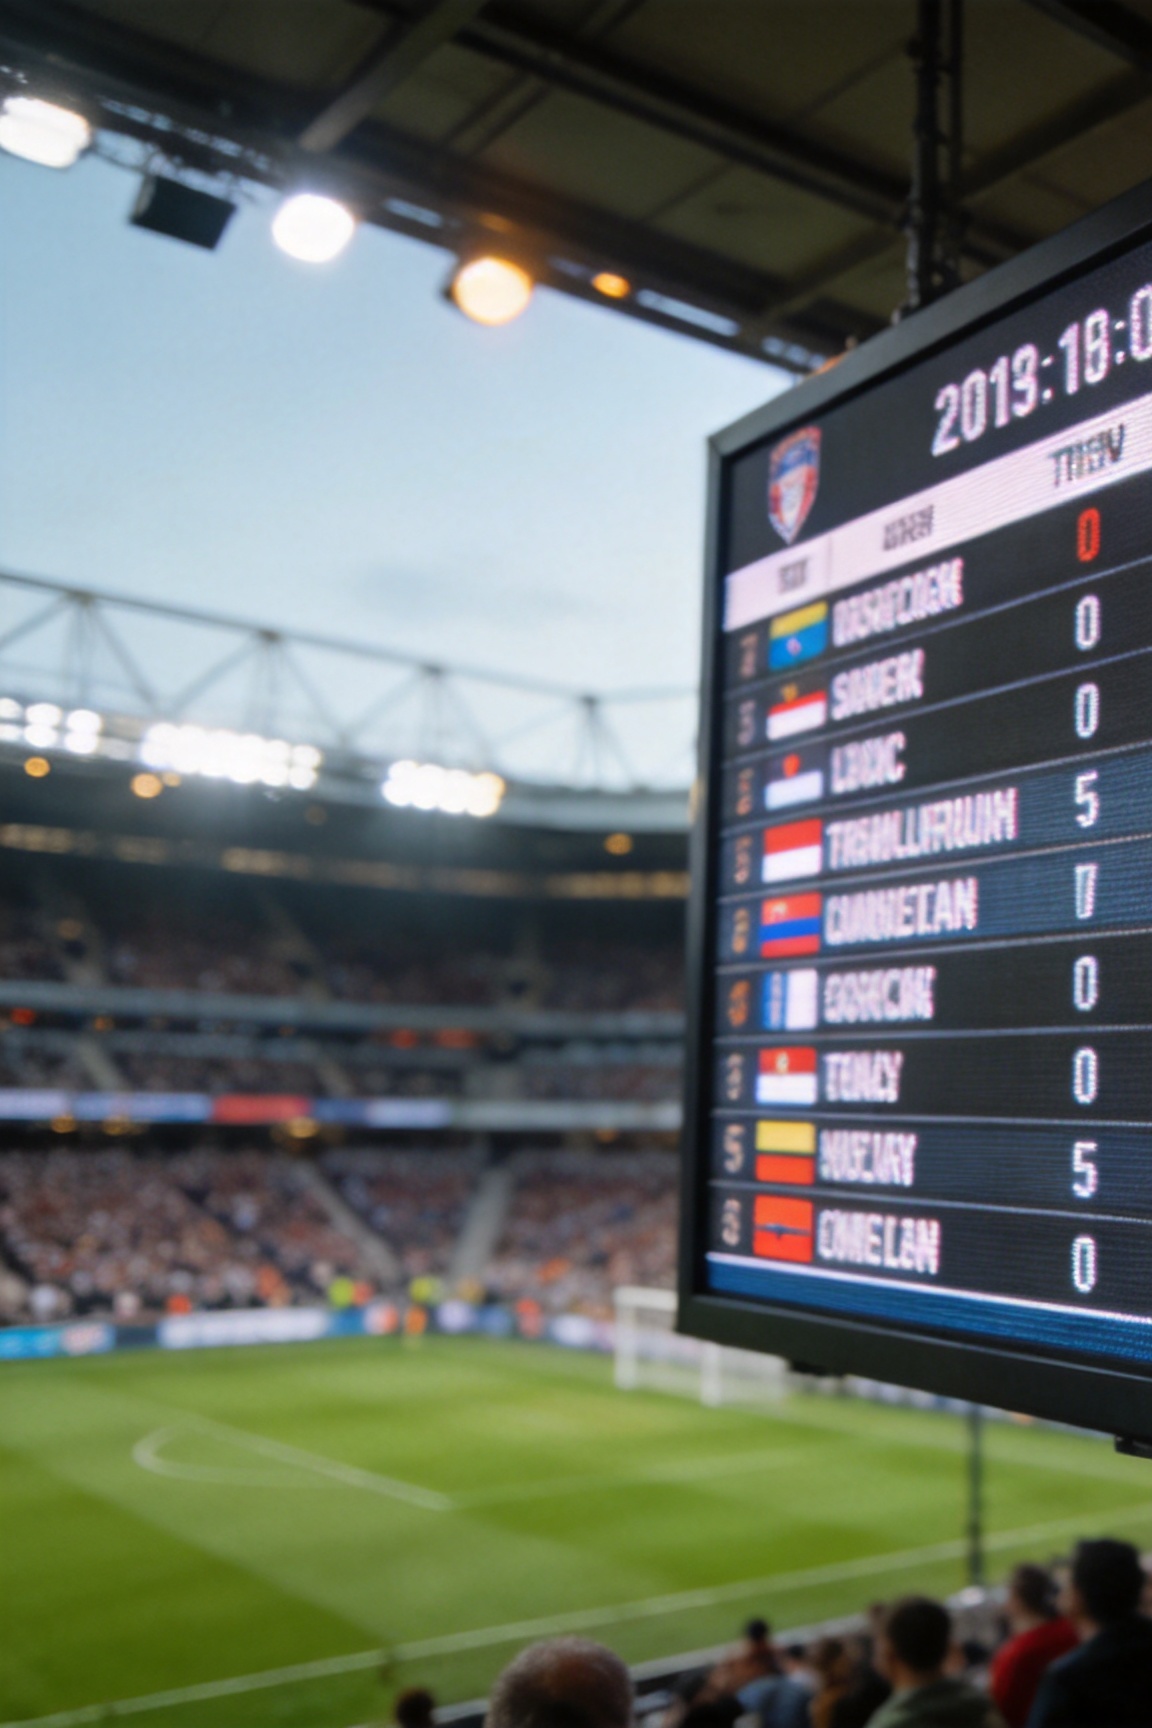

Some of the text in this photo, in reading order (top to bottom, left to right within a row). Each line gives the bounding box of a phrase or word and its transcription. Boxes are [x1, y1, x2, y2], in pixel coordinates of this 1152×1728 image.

[1076, 507, 1100, 562] 0
[1075, 594, 1100, 651] 0
[1074, 683, 1100, 739] 0
[1075, 770, 1100, 829] 5
[1074, 955, 1099, 1011] 0
[1073, 1047, 1099, 1104] 0
[1072, 1140, 1099, 1198] 5
[1071, 1235, 1098, 1294] 0
